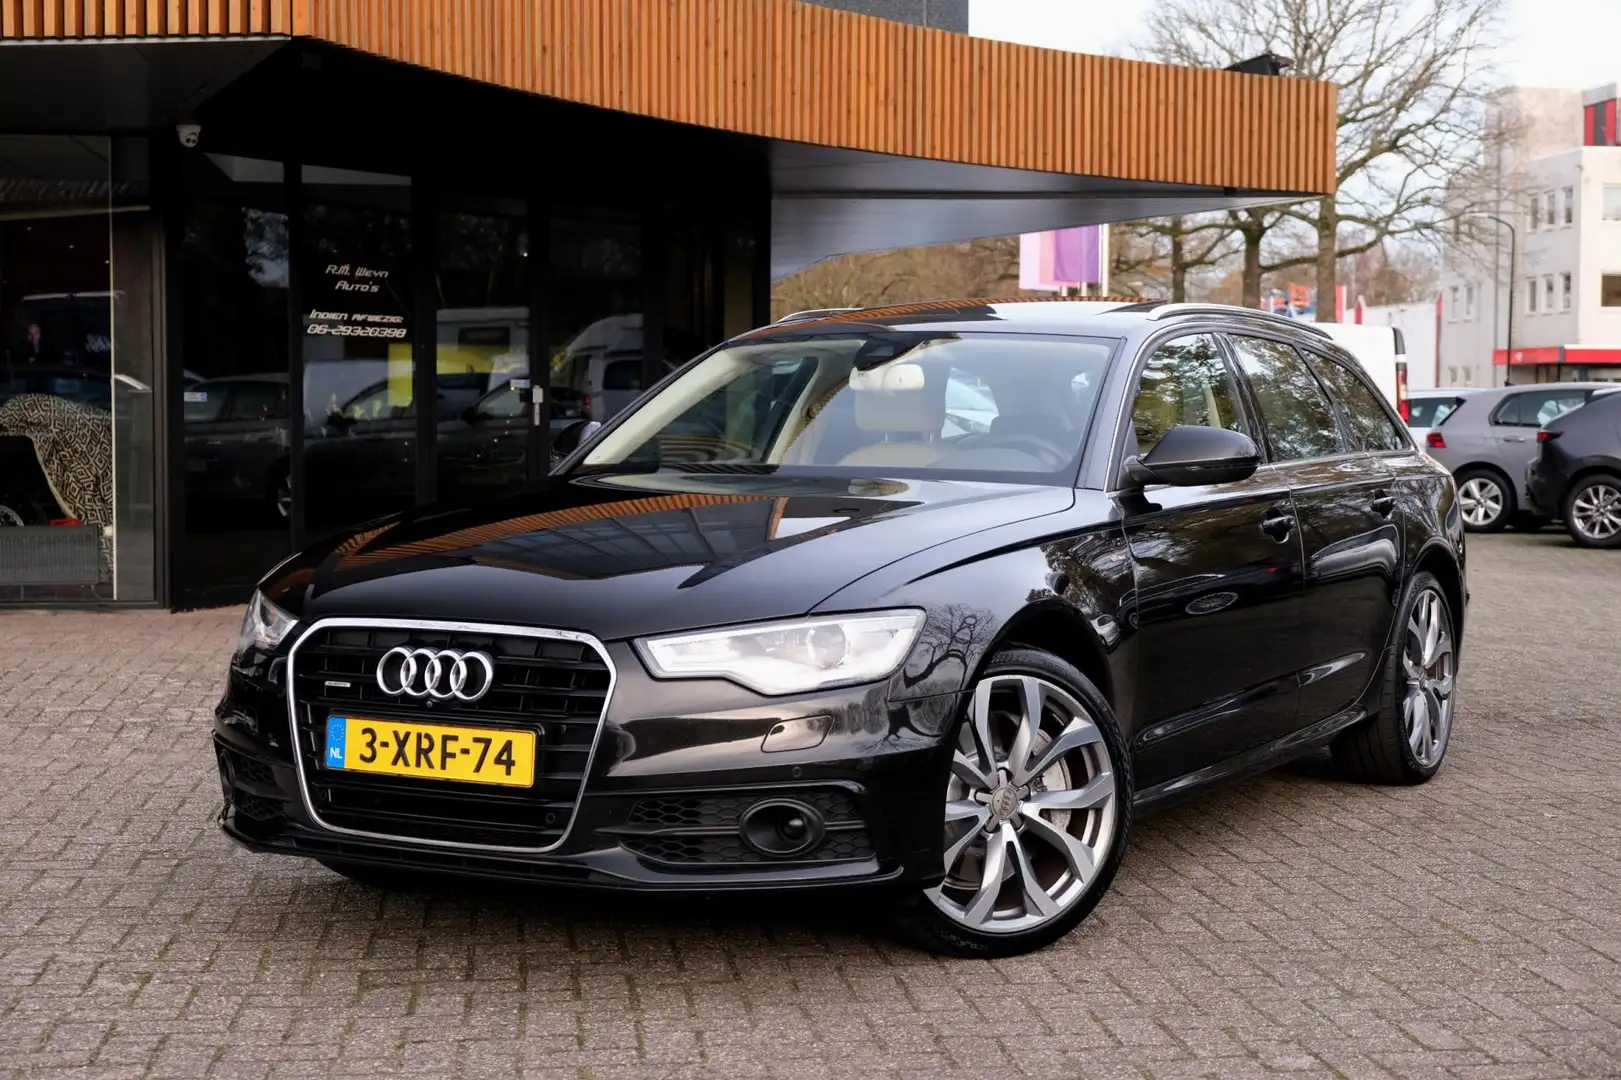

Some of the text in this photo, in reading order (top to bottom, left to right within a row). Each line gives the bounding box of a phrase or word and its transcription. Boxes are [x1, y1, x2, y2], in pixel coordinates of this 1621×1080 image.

[307, 323, 407, 338] 06-29320398
[330, 747, 343, 760] NL
[359, 727, 516, 776] 3-XRF-74
